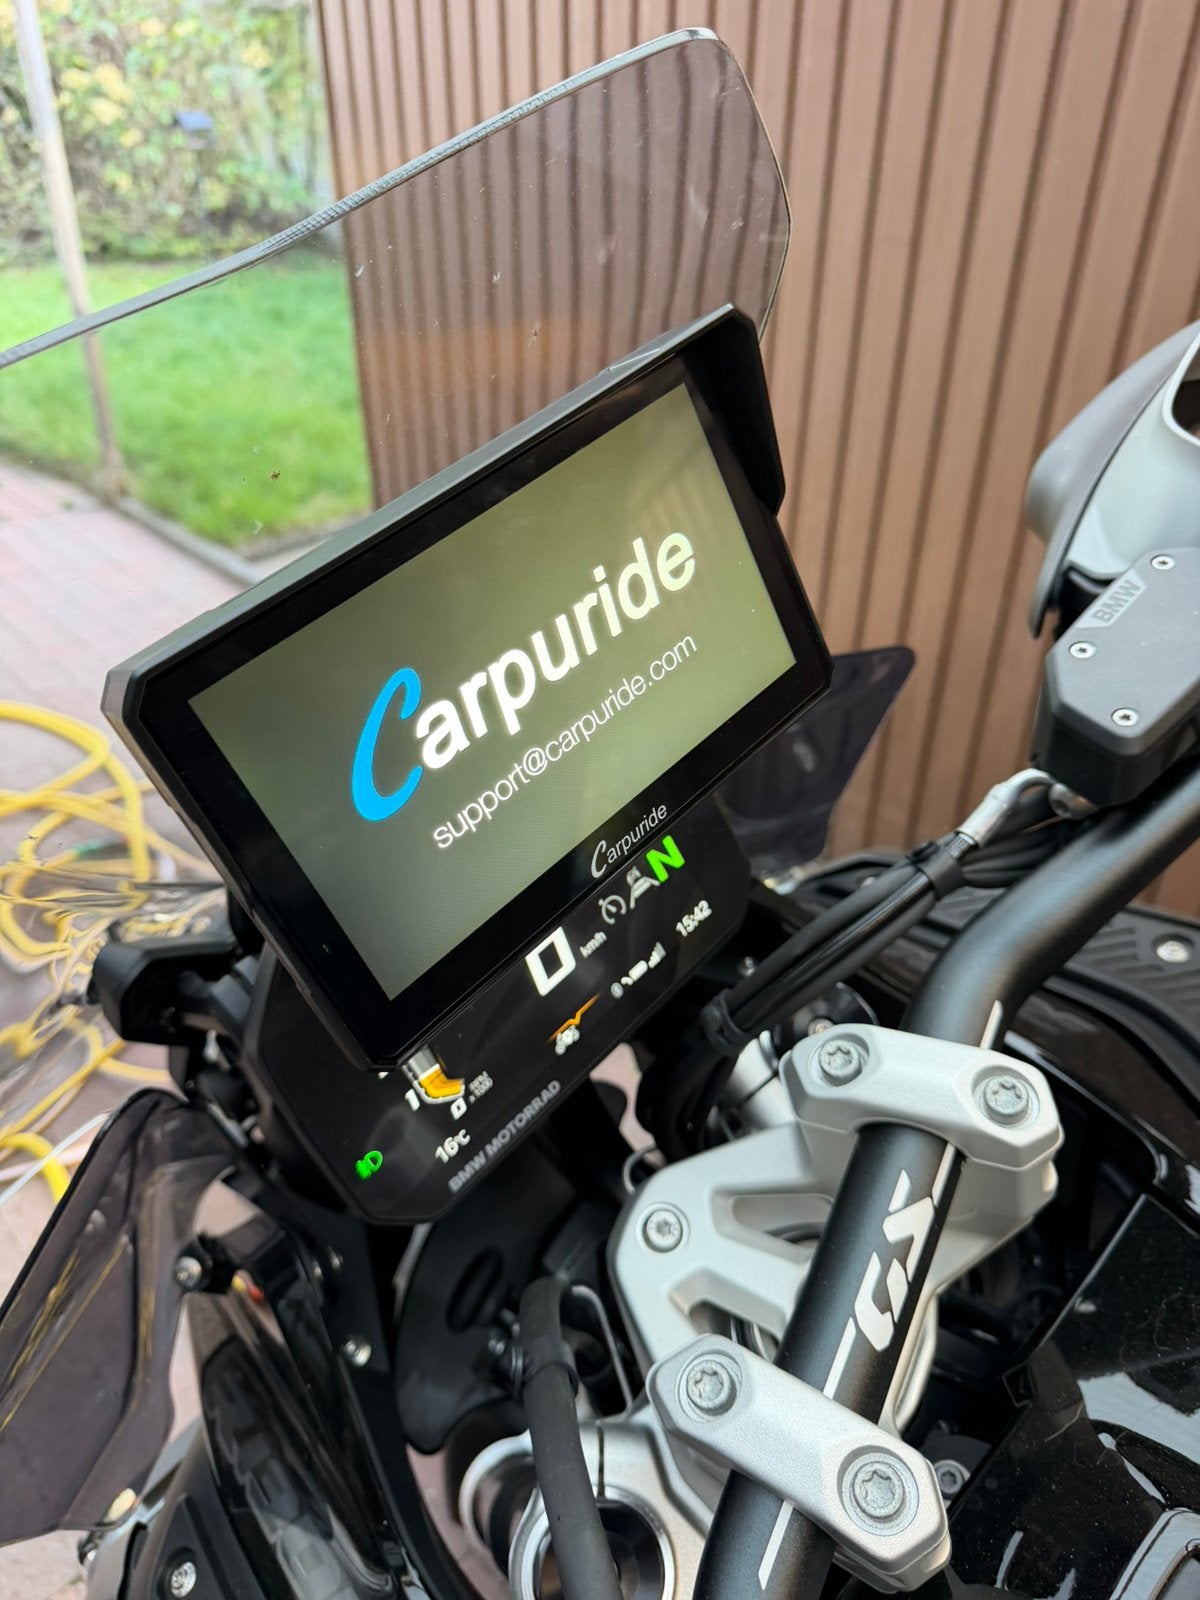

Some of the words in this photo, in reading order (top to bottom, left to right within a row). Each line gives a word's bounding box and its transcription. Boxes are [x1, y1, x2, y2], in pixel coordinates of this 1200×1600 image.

[1091, 579, 1142, 624] BMW
[352, 532, 696, 822] Carpuride
[432, 635, 698, 849] support@carpuride.com
[590, 804, 668, 878] Carpuride
[646, 835, 685, 883] N
[676, 900, 712, 937] 15:42
[405, 1088, 420, 1111] 1
[448, 1150, 487, 1192] BMW
[485, 1080, 561, 1156] MOTORRAD
